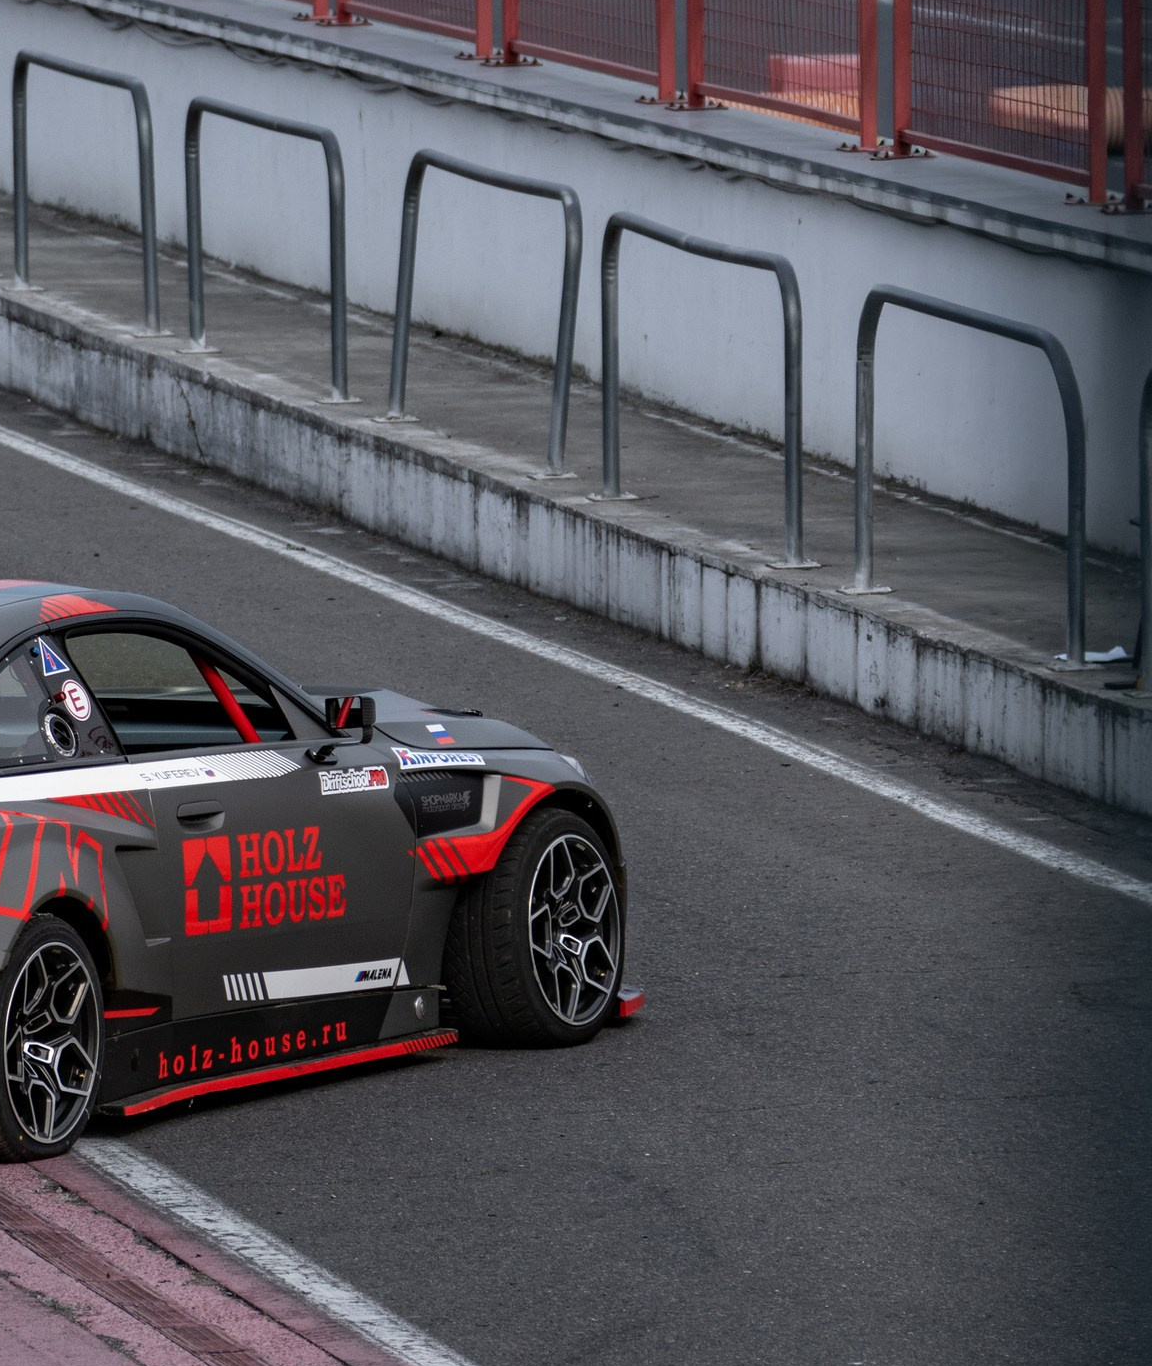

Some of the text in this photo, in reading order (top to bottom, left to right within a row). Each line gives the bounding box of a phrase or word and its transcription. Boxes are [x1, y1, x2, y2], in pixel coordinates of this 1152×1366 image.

[67, 688, 85, 712] E
[399, 748, 483, 766] KINFOREST
[421, 791, 464, 806] SHOPMARKA
[237, 826, 323, 878] HOLZ
[239, 874, 347, 929] HOUSE
[158, 1021, 347, 1079] holz-house.ru
